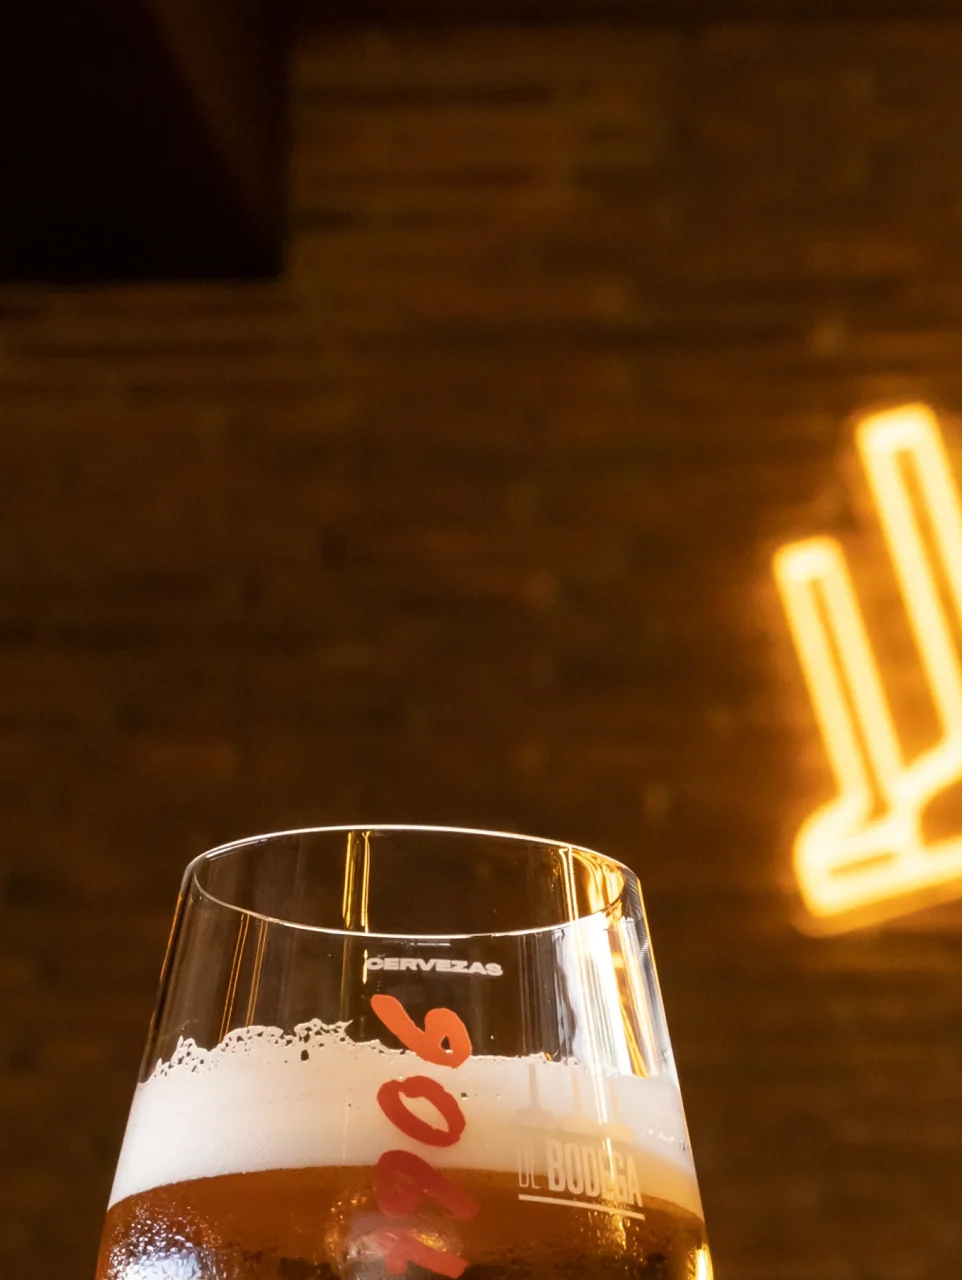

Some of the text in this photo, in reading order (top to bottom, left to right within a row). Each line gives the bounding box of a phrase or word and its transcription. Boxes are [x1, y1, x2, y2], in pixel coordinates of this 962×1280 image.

[366, 957, 503, 976] CERVEZAS
[370, 994, 481, 1280] 1906
[546, 1139, 644, 1208] BODEGA
